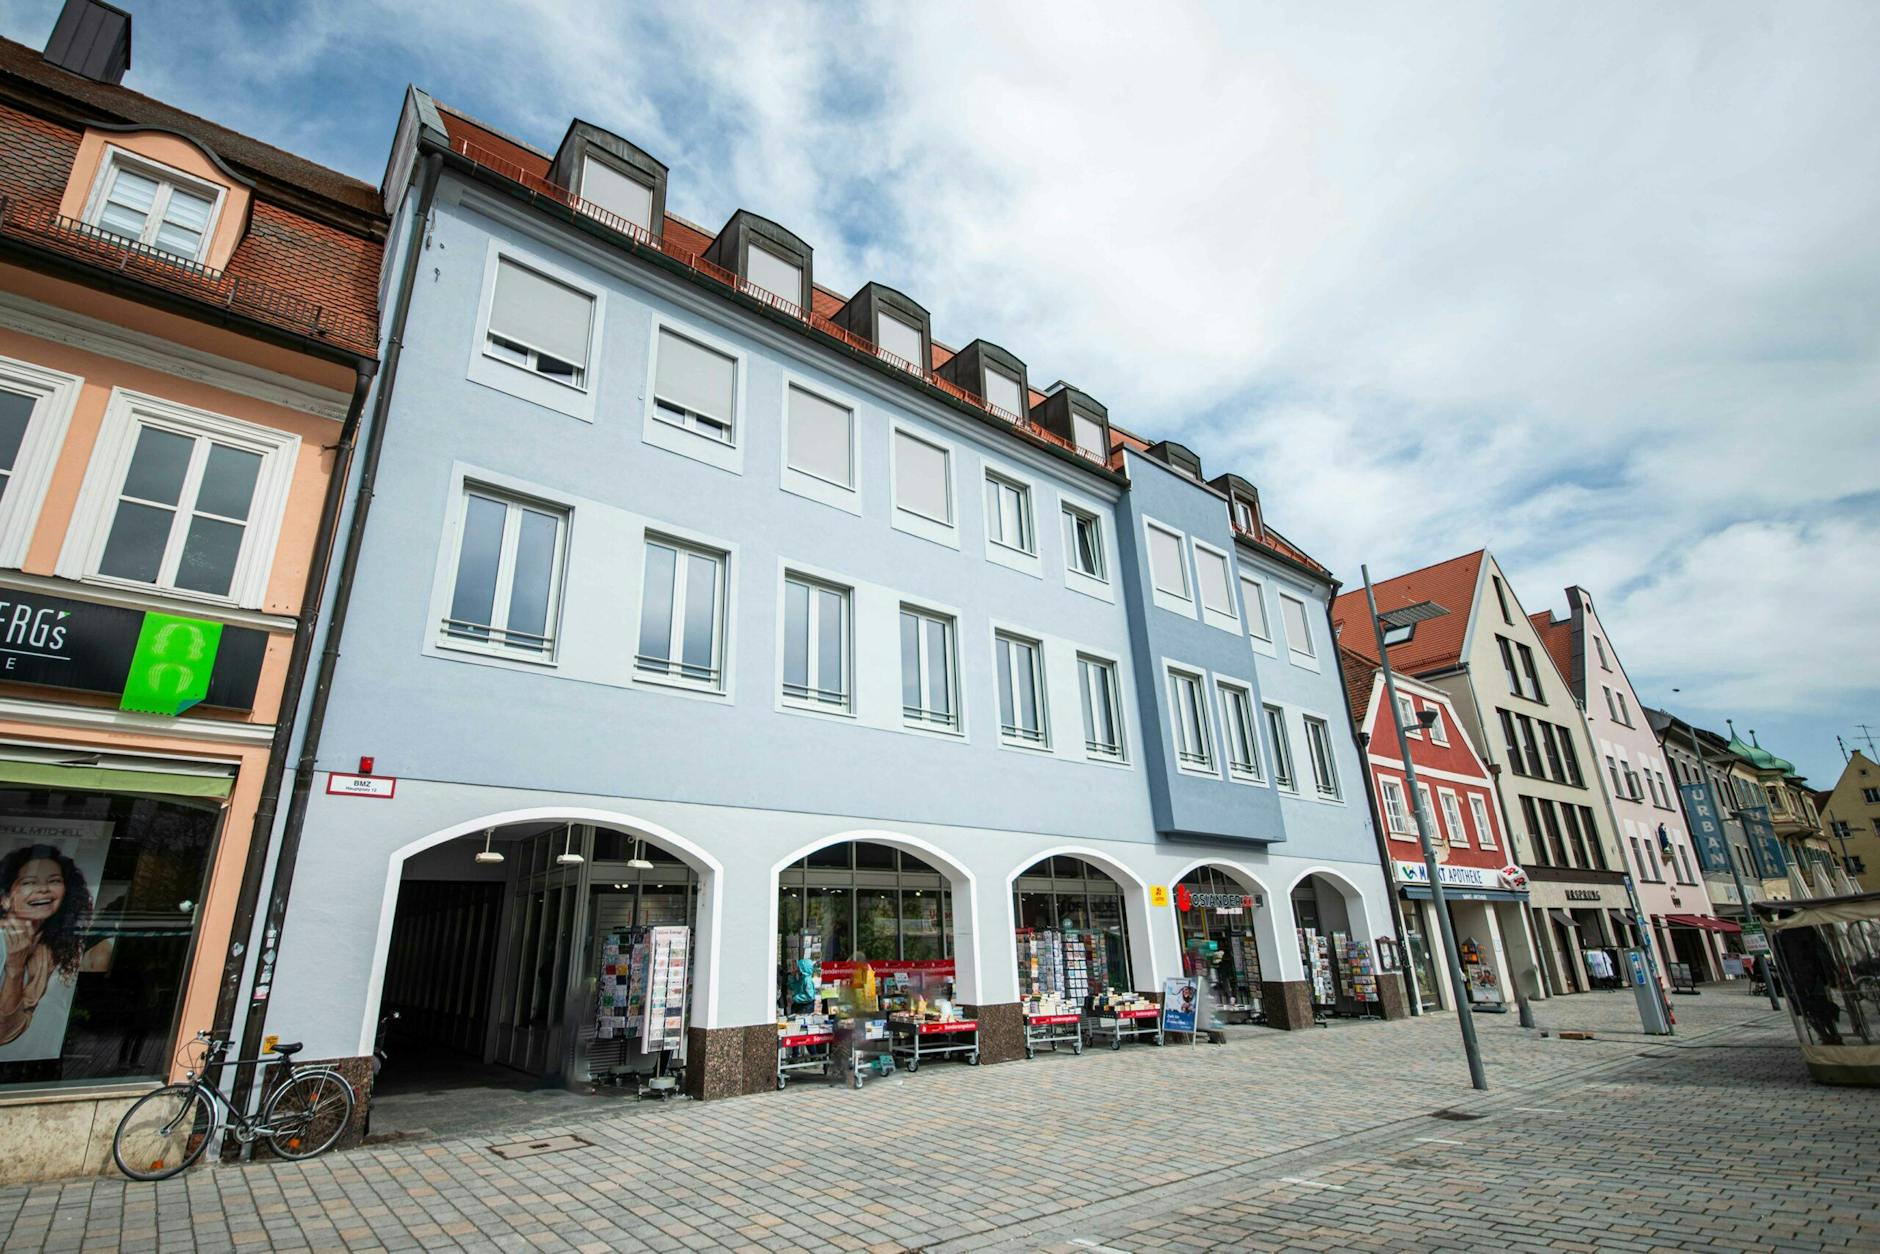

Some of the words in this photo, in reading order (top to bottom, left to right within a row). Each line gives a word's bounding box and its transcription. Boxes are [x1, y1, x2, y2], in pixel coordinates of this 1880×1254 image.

[1691, 788, 1726, 866] URBAN
[1749, 812, 1779, 875] URBAN
[1418, 864, 1447, 883] MKT
[1449, 867, 1484, 885] APOTHEKE
